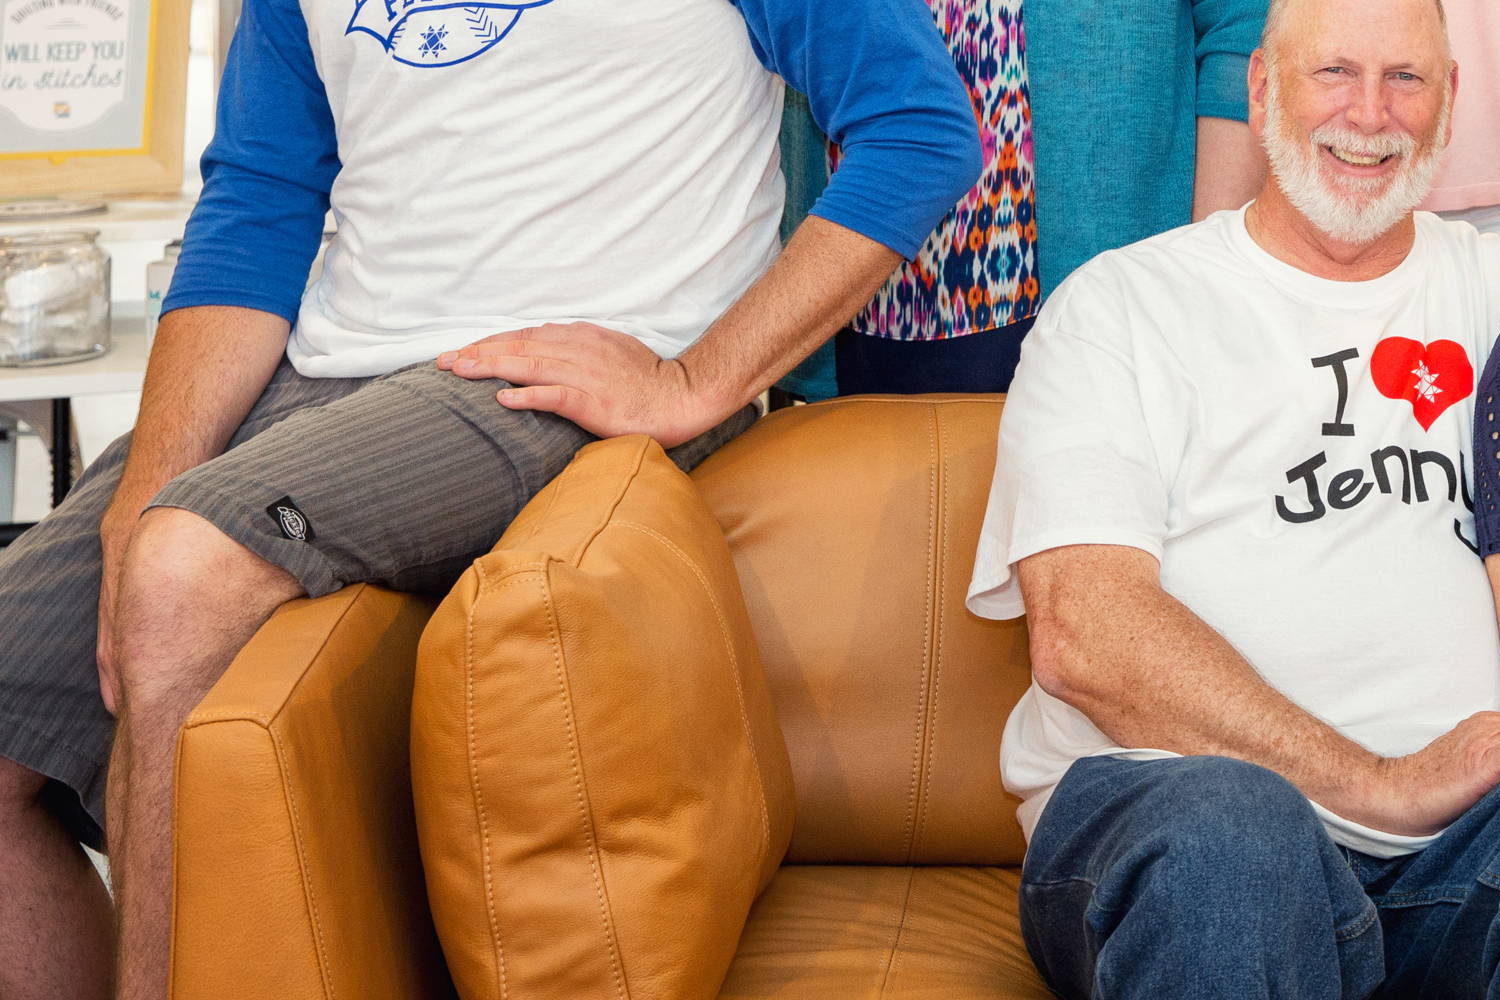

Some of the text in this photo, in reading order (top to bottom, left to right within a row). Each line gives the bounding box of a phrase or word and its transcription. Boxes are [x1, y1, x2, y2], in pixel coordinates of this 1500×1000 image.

[4, 40, 125, 64] WILL KEEP YOU
[1, 63, 123, 92] in stitches
[1311, 347, 1360, 437] I
